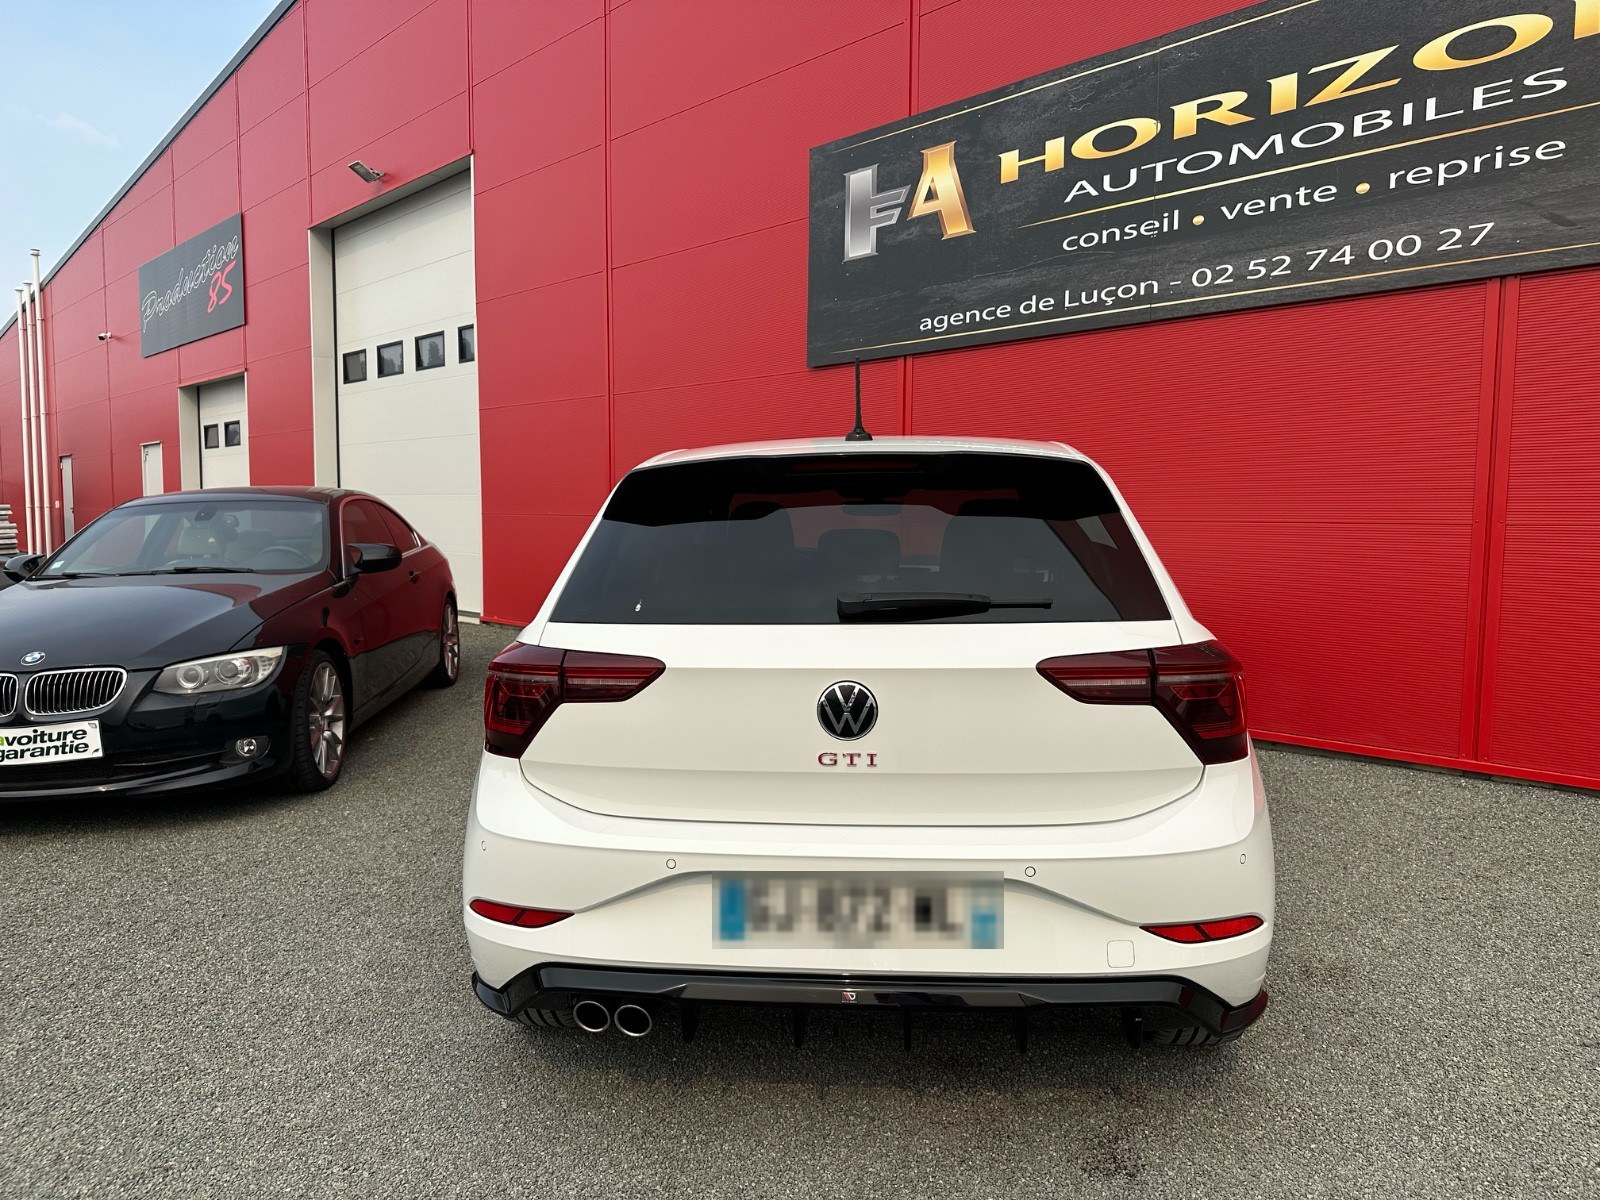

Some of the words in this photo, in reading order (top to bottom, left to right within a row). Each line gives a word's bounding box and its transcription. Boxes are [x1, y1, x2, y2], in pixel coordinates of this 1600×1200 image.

[998, 0, 1600, 184] HORIZO
[1064, 67, 1567, 203] AUTOMOBILES
[1062, 209, 1180, 251] conseil
[1220, 184, 1338, 221] vente
[1389, 140, 1567, 189] reprise
[141, 235, 240, 334] Production
[207, 260, 237, 313] 85
[919, 302, 1012, 333] agence
[1019, 295, 1055, 314] de
[1064, 279, 1159, 305] Luçon
[1191, 264, 1234, 287] 02
[1246, 255, 1292, 280] 52
[1305, 245, 1355, 272] 74
[1367, 234, 1422, 261] 00
[1436, 221, 1495, 252] 27
[817, 751, 878, 768] GTI
